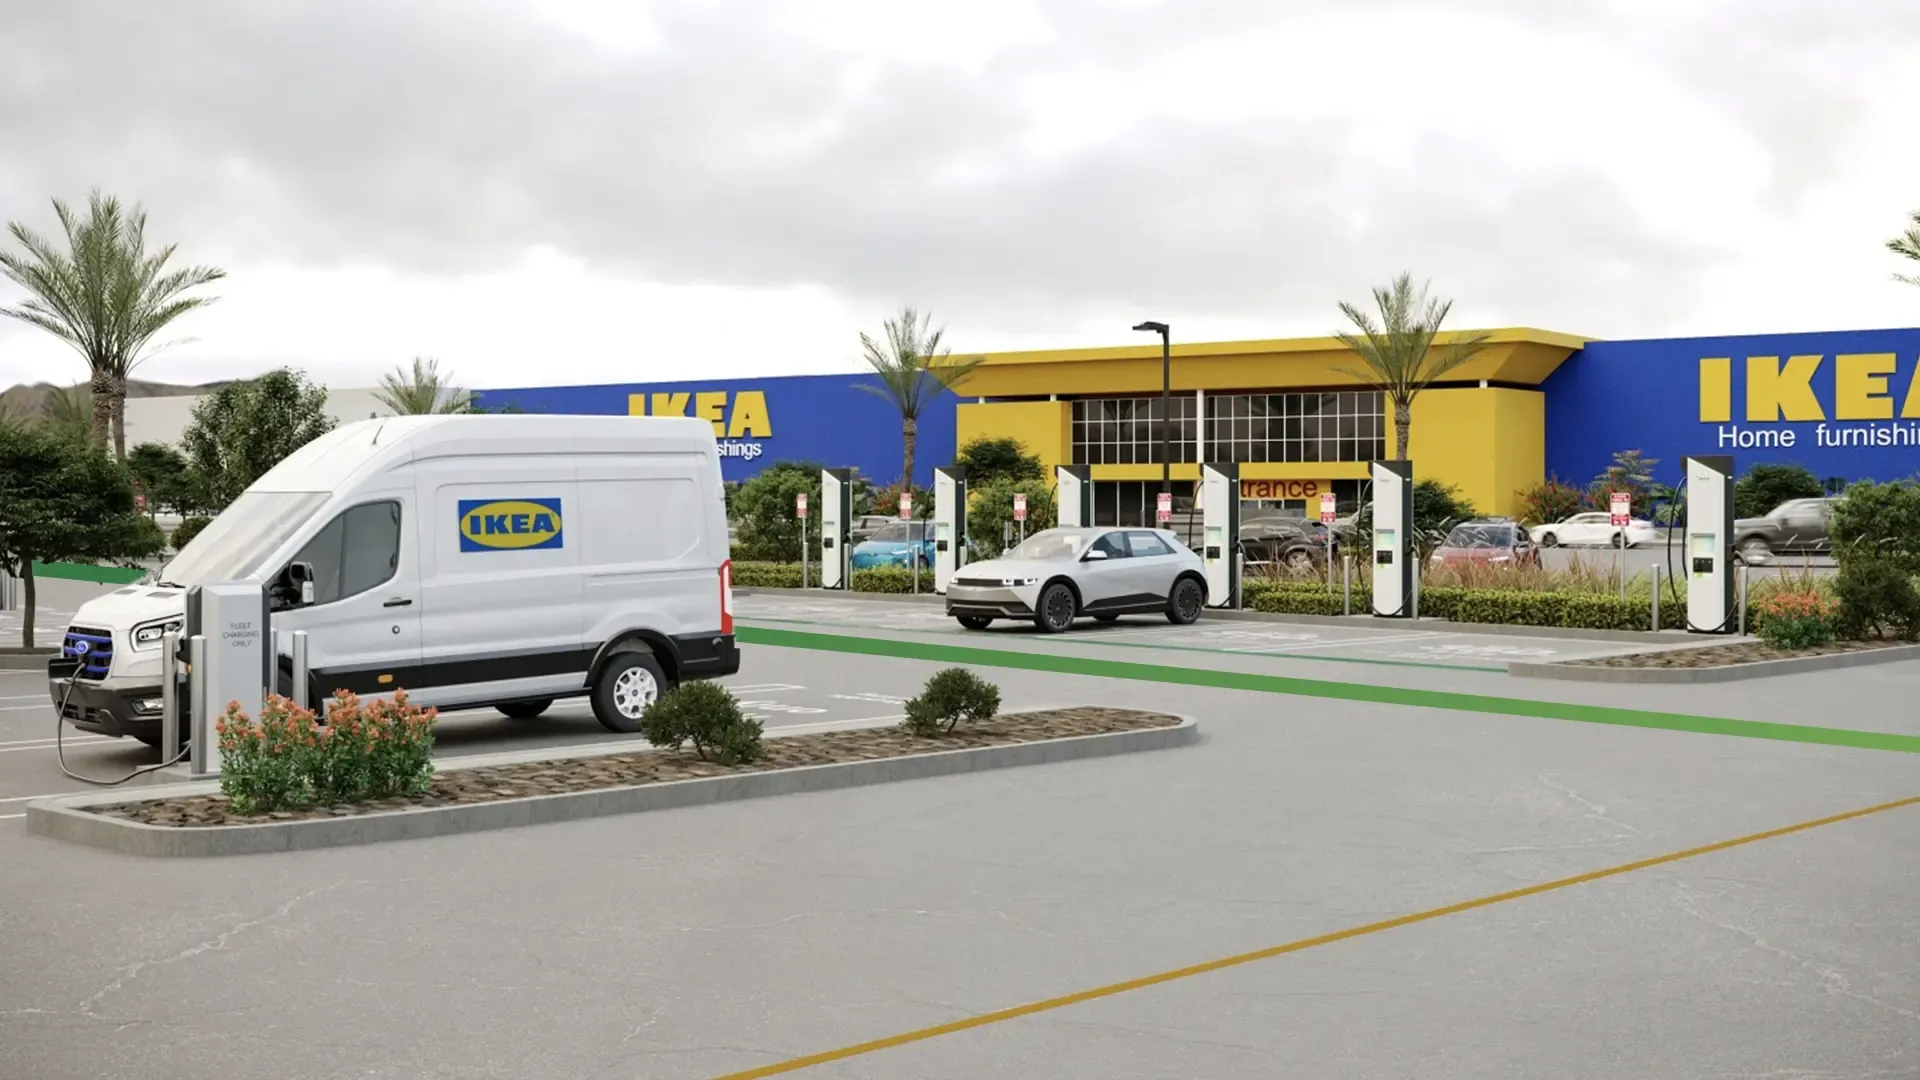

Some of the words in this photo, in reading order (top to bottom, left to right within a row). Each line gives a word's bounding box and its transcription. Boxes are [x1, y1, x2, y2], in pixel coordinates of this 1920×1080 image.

[1718, 425, 1796, 448] Home
[1816, 422, 1920, 446] furnishi
[469, 513, 556, 535] IKEA
[230, 622, 252, 630] FLEET
[222, 630, 260, 639] CHARGING
[232, 640, 252, 648] ONLY
